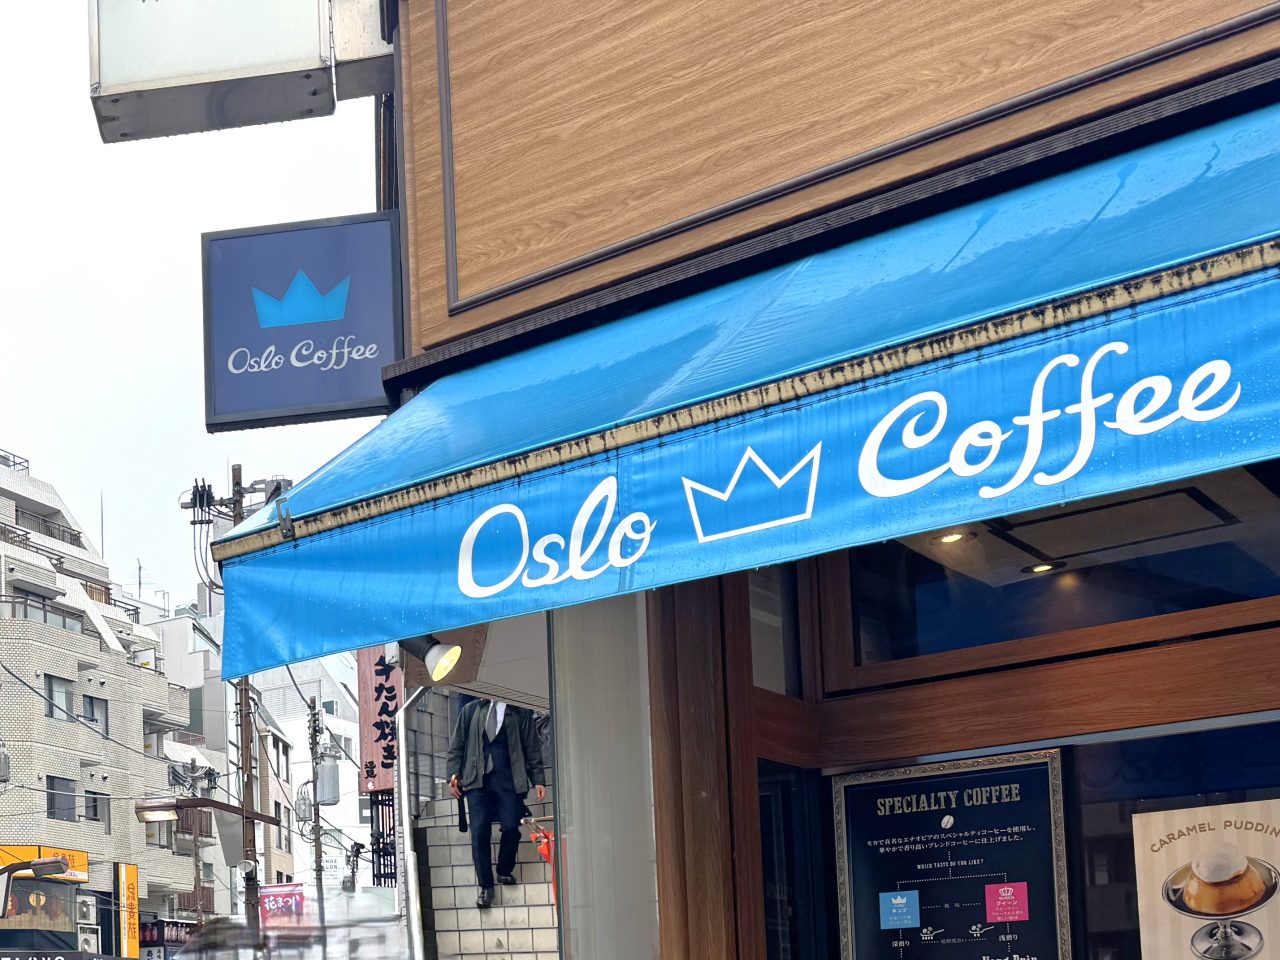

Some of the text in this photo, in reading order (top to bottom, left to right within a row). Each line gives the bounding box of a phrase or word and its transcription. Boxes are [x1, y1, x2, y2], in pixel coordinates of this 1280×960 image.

[227, 335, 379, 375] Oslo Coffee
[457, 340, 1243, 599] Oslo Coffee
[877, 784, 1021, 816] SPECIALTY COFFEE
[1151, 822, 1216, 853] CARAMEL
